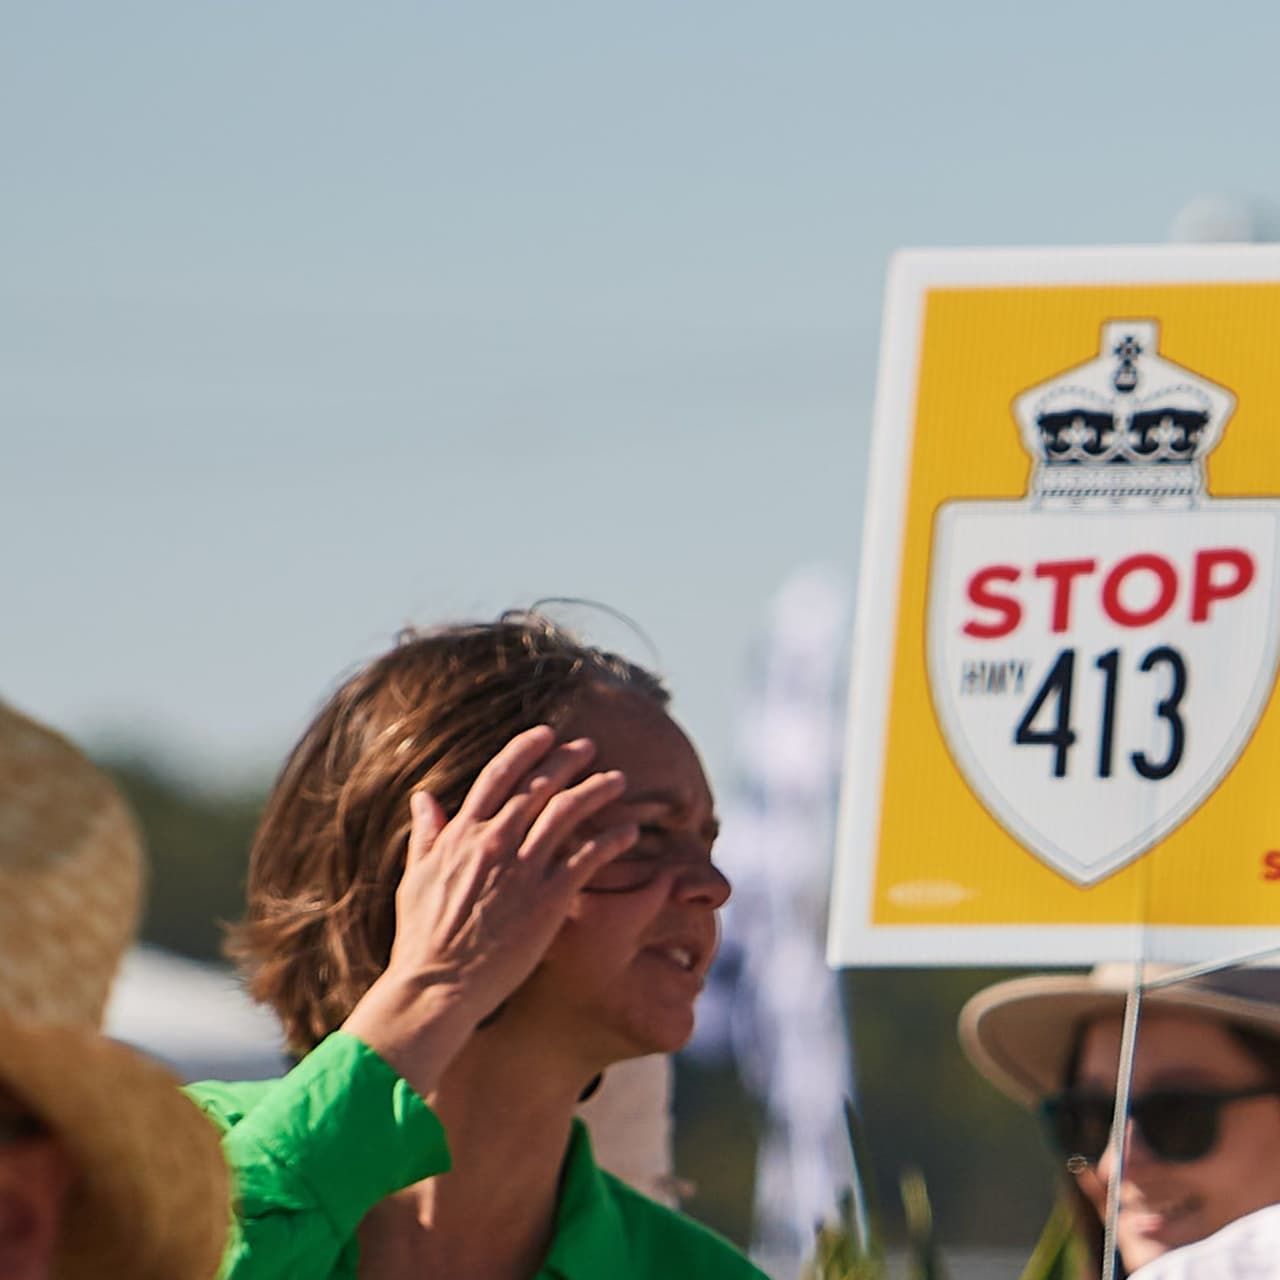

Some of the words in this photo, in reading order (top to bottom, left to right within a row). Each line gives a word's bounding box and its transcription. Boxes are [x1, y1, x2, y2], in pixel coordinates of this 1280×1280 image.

[962, 548, 1256, 639] STOP
[962, 659, 1028, 695] HWY
[1014, 646, 1188, 781] 413
